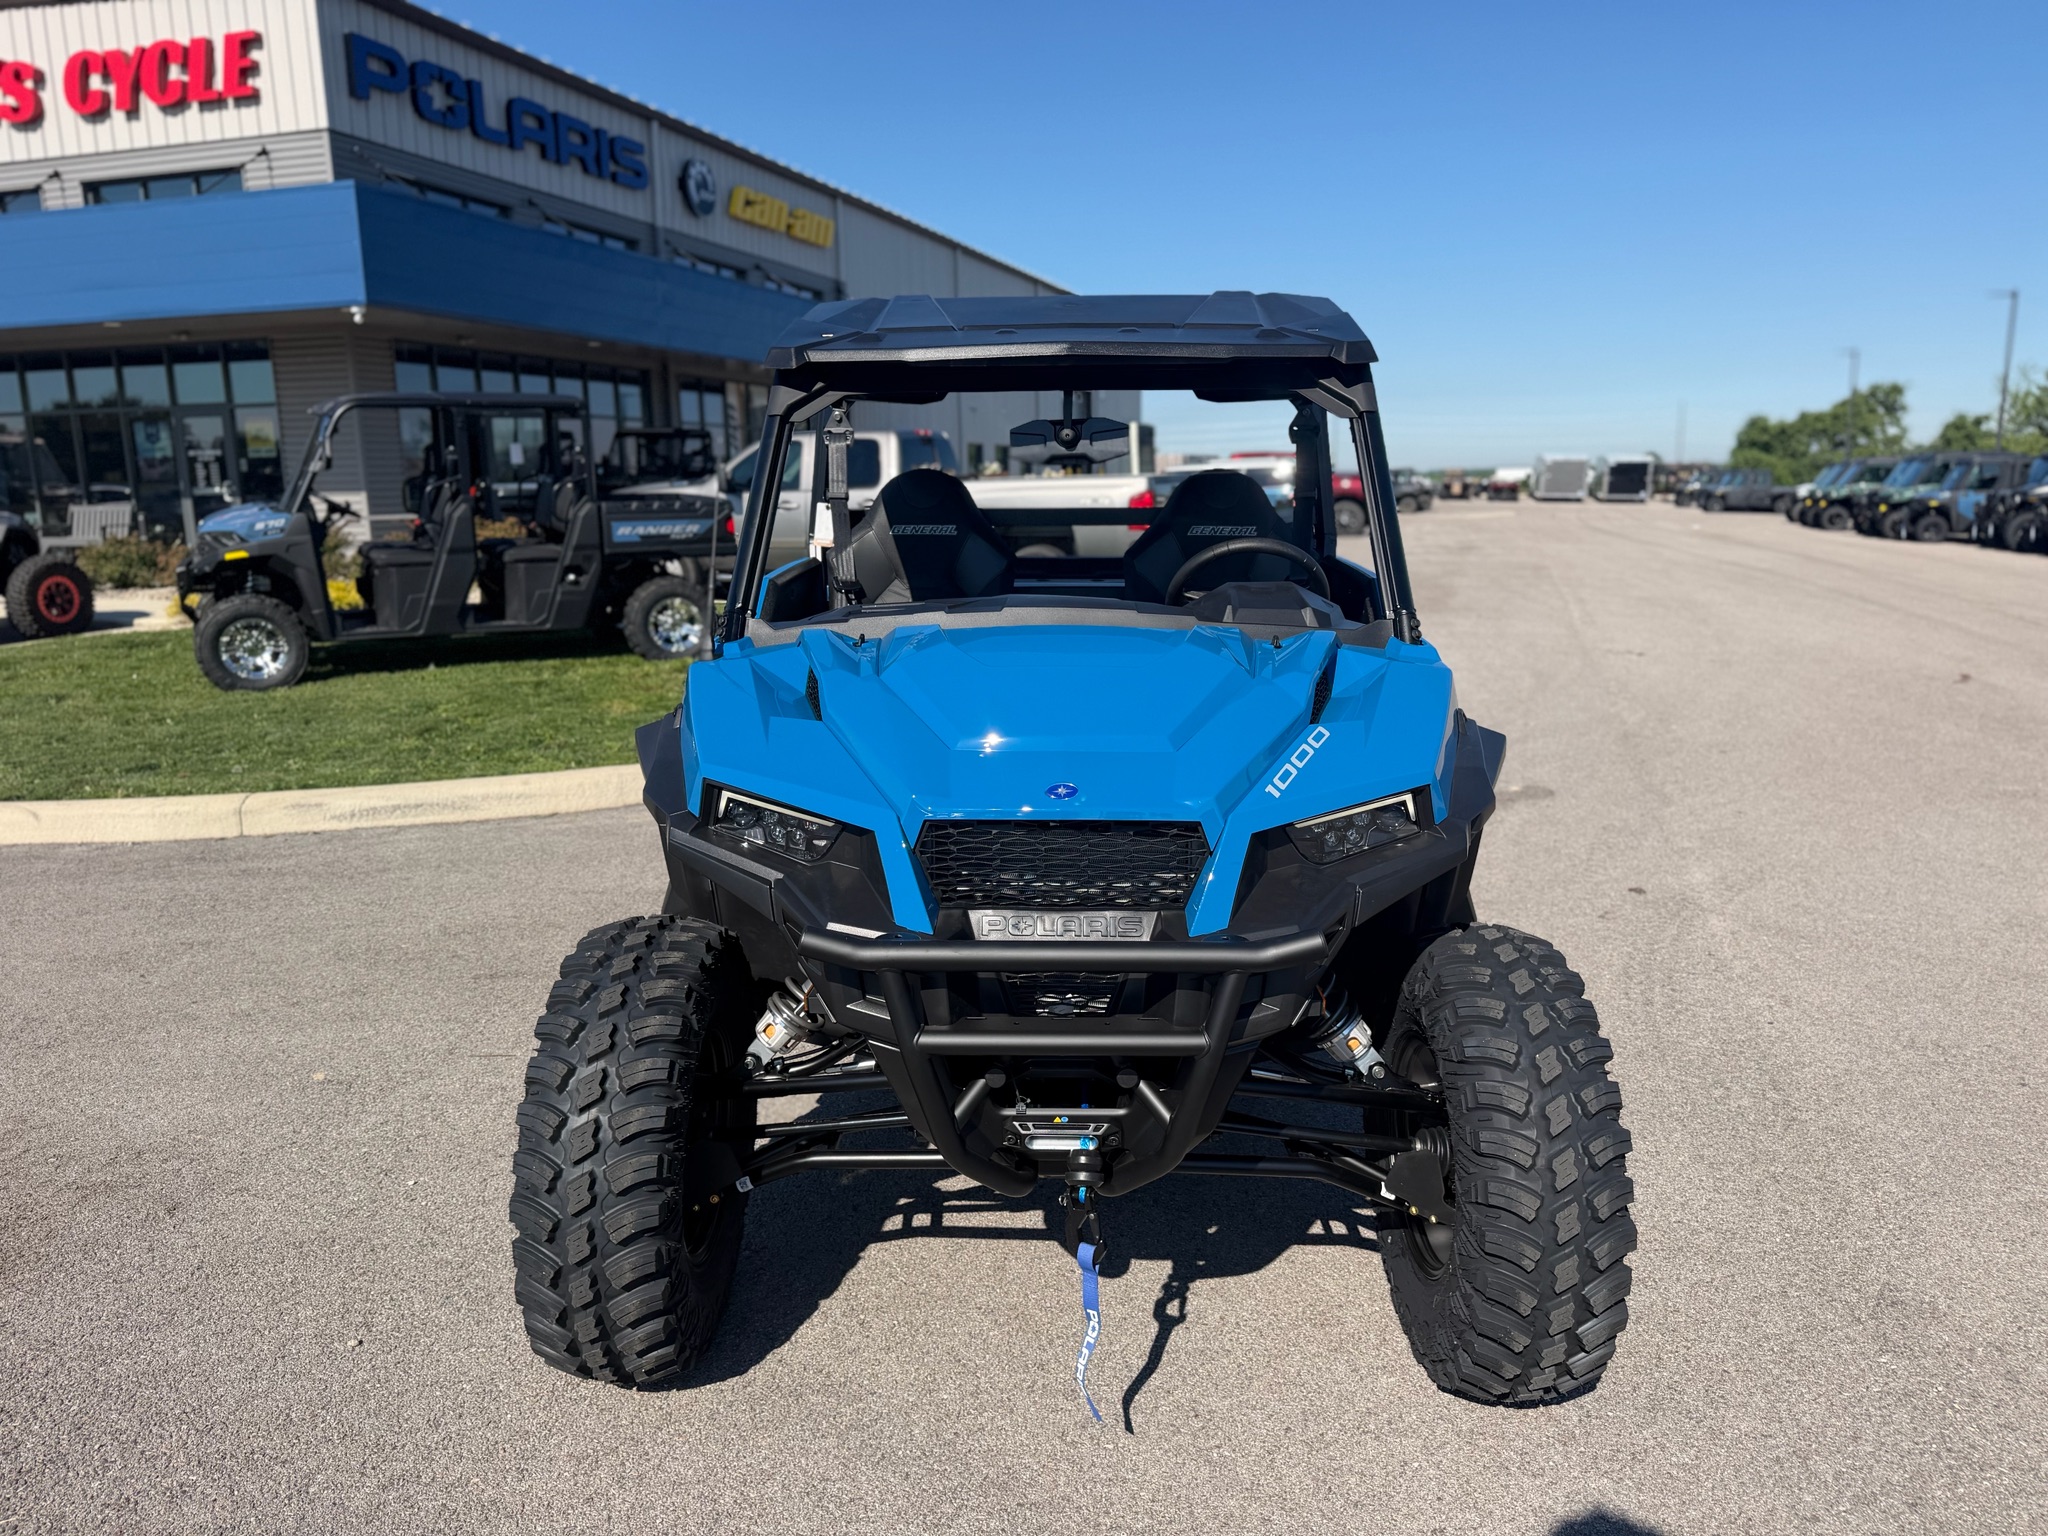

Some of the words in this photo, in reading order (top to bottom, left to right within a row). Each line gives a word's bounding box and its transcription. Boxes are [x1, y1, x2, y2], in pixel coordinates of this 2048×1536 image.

[63, 30, 261, 117] CYCLE
[345, 33, 649, 190] POLARIS
[729, 185, 834, 248] can-am
[617, 524, 701, 536] RANGER
[889, 524, 958, 536] GENERAL
[1187, 525, 1258, 537] GENERAL
[1264, 725, 1331, 799] 1000
[981, 915, 1145, 938] POLARIS
[1076, 1308, 1099, 1397] POLAR
